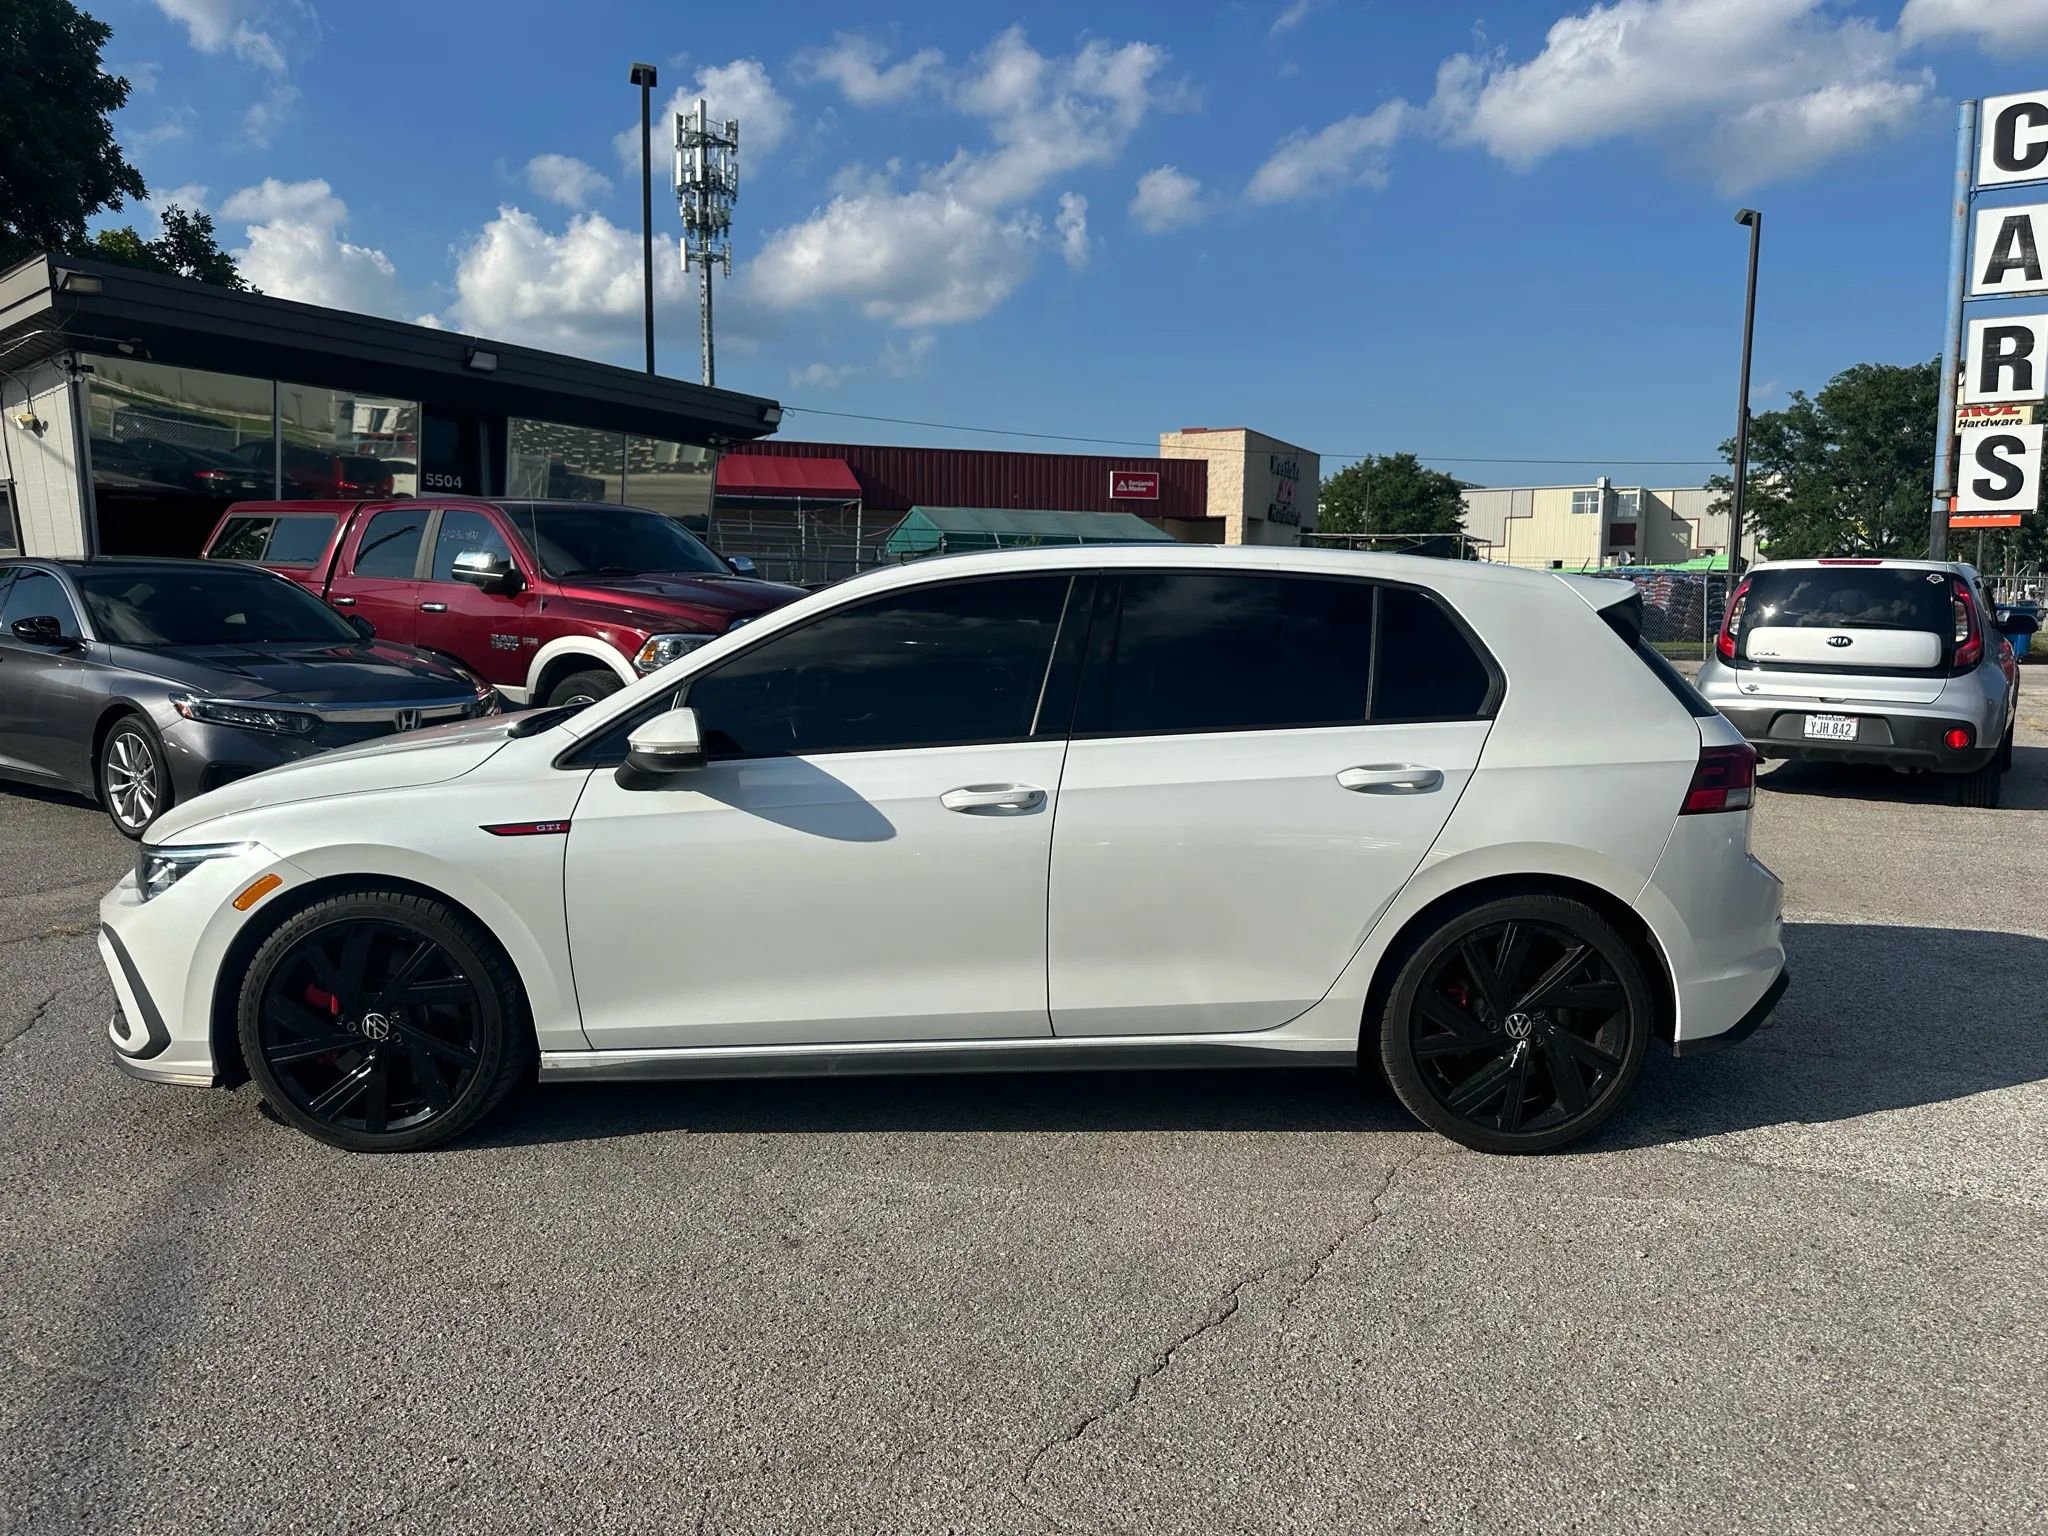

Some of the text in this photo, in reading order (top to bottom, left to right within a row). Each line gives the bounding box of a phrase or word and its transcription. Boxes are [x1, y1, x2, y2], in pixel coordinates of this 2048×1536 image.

[1957, 417, 2023, 429] Hardware
[426, 473, 462, 489] 5504
[1830, 637, 1849, 646] KIA
[1811, 721, 1852, 736] YJH 842
[536, 823, 561, 832] GTI
